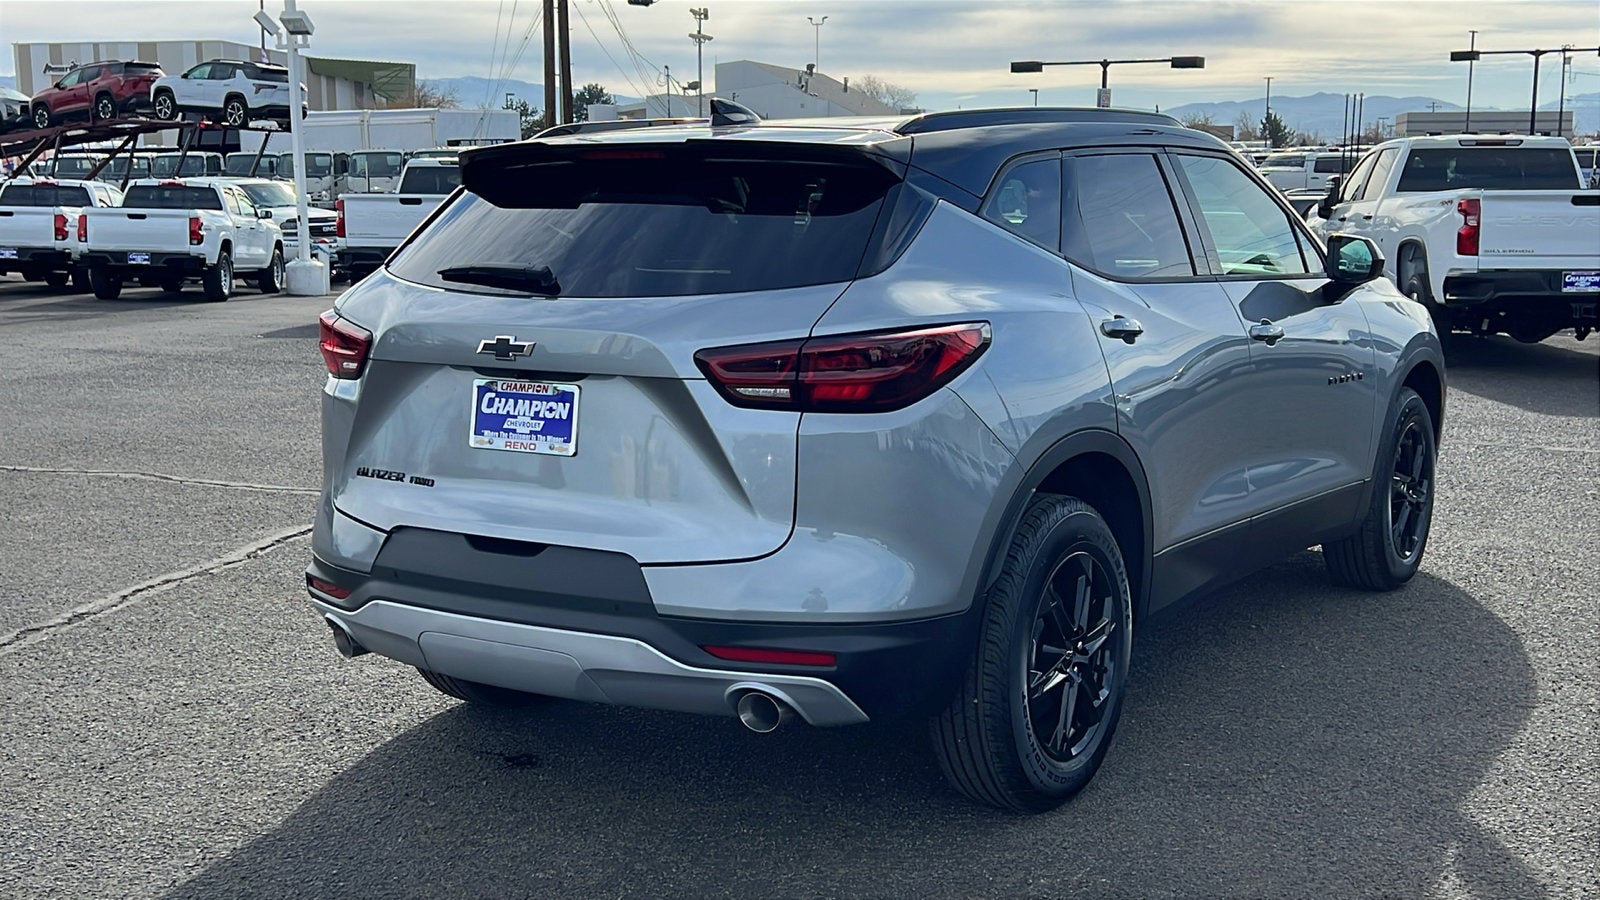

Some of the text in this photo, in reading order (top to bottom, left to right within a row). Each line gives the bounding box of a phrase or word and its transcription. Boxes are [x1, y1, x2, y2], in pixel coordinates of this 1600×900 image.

[501, 382, 549, 393] CHAMPION
[481, 392, 570, 420] CHAMPION
[506, 419, 541, 429] CHEVROLET
[505, 441, 537, 451] RENO
[356, 467, 406, 483] BLAZER
